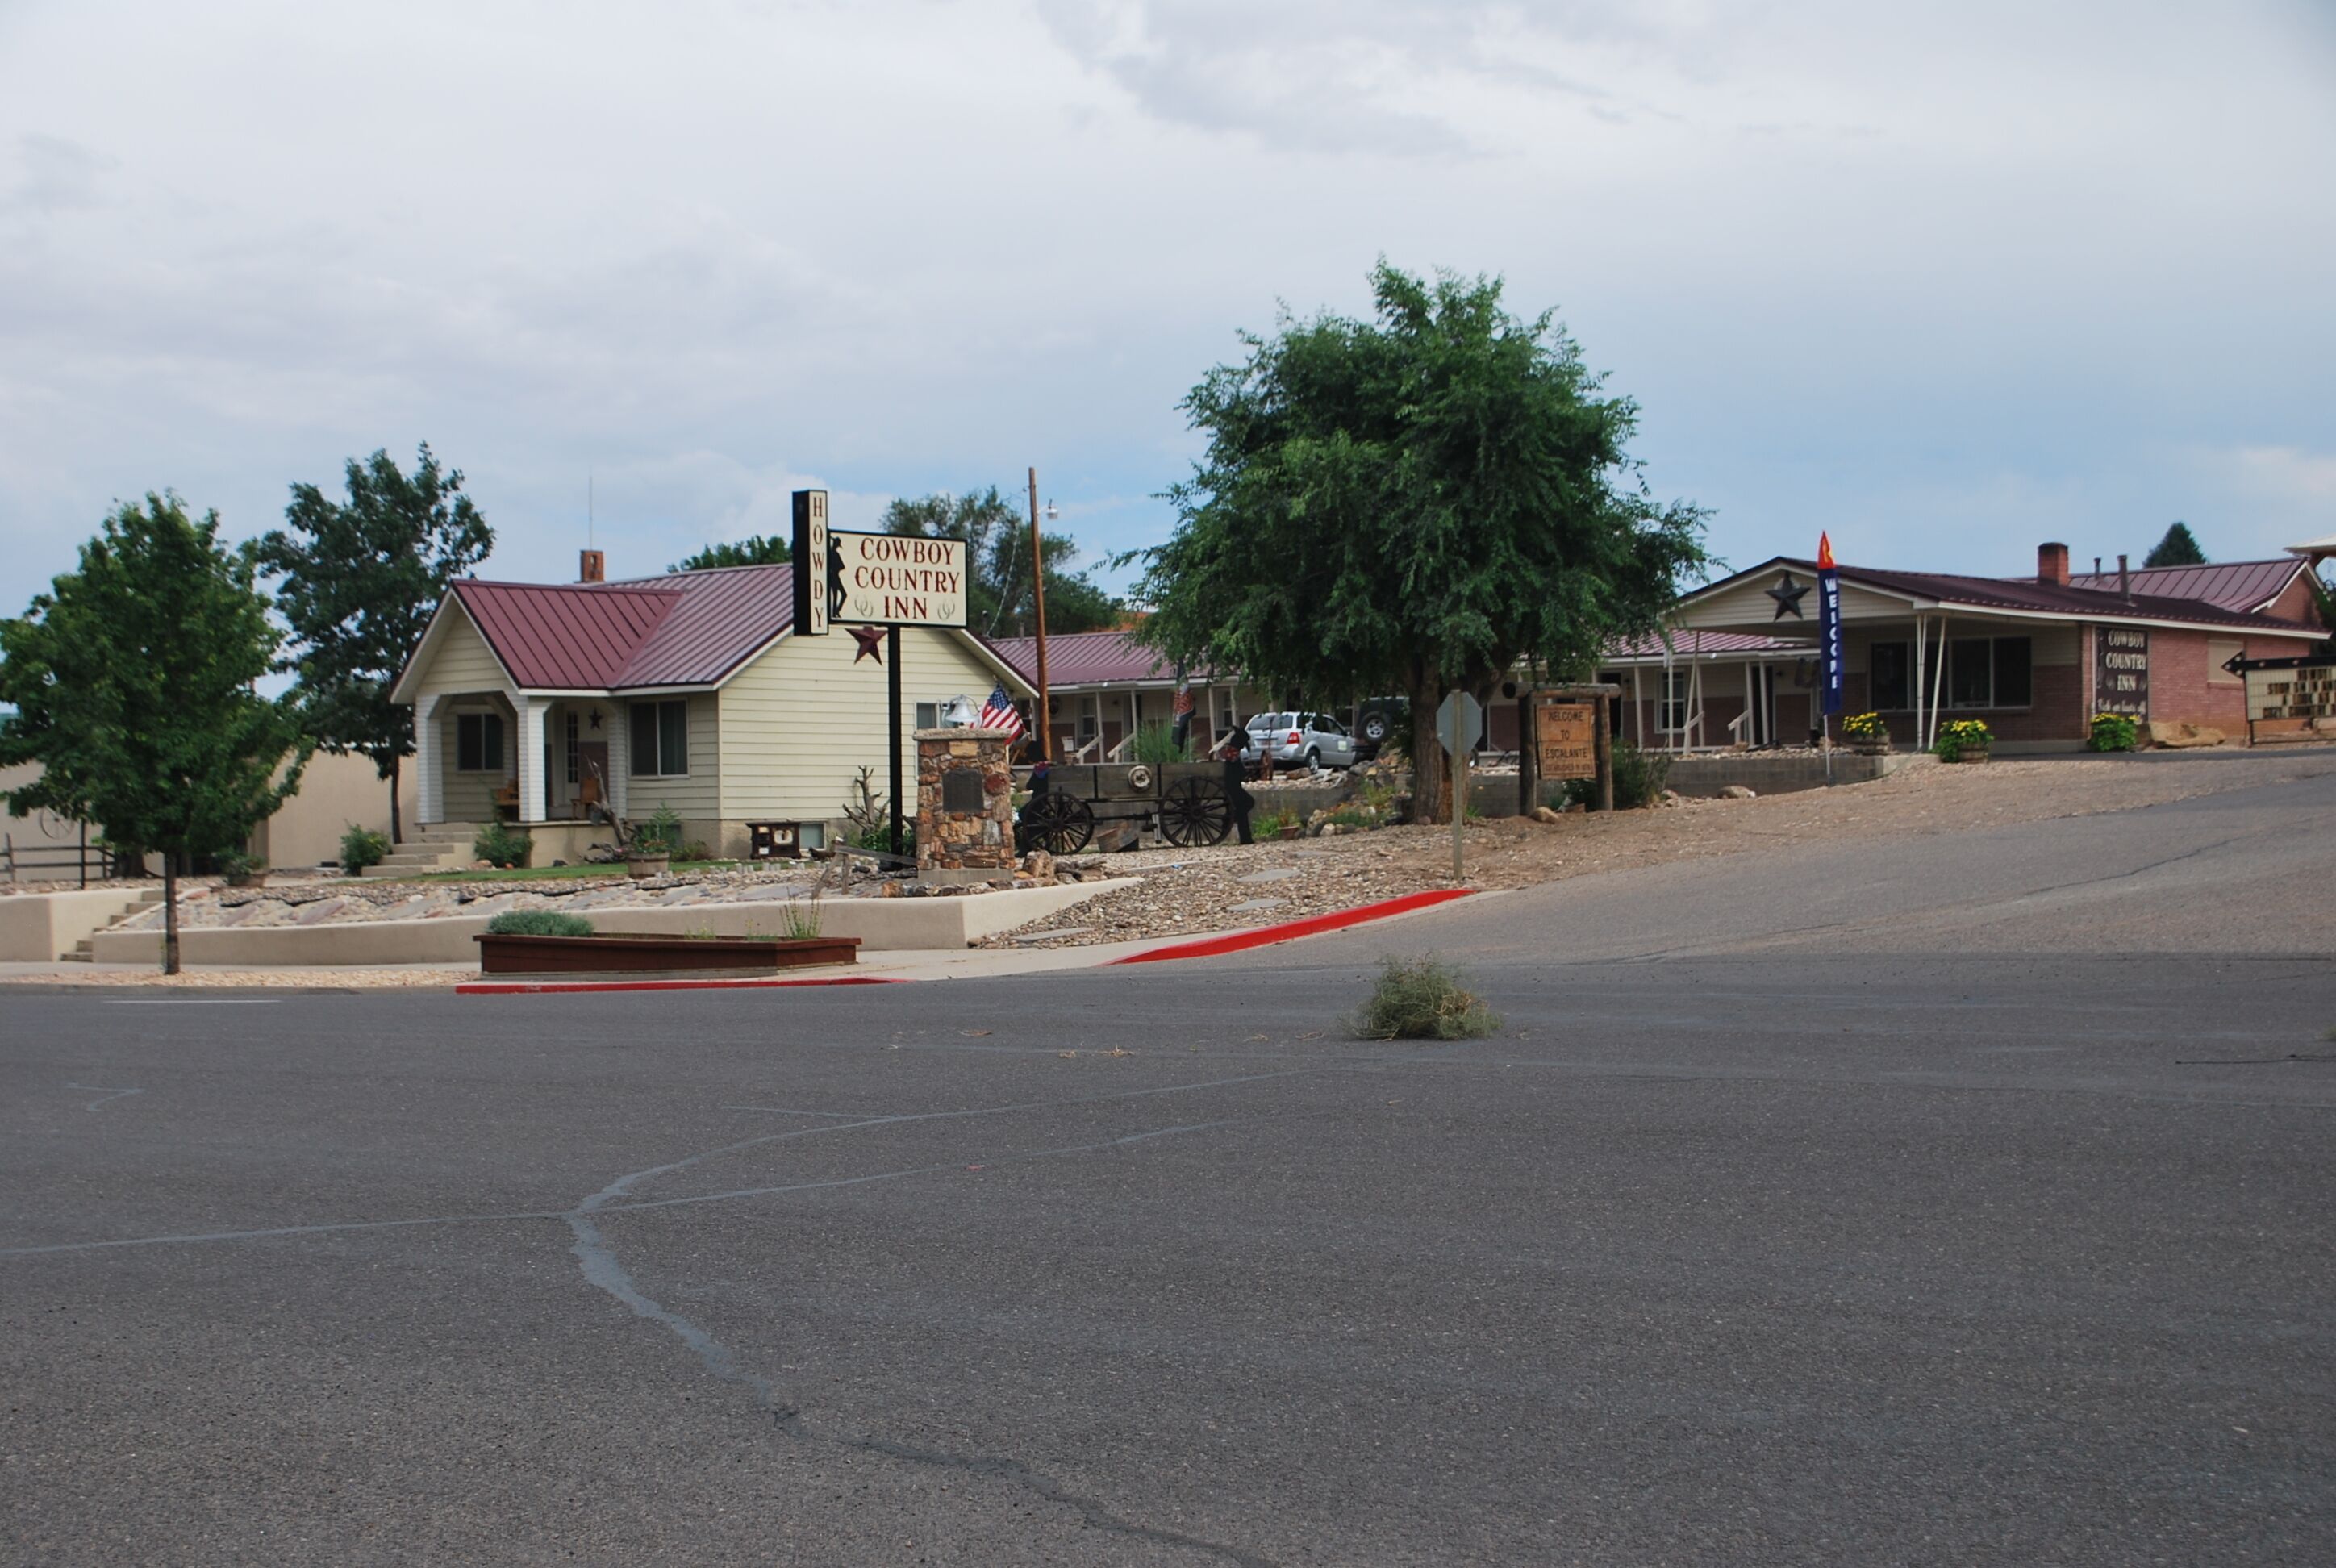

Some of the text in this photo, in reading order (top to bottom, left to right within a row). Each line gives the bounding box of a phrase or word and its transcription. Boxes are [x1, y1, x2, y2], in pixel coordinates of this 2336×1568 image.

[860, 537, 954, 565] COWBOY
[812, 497, 824, 628] HOWDY
[854, 565, 960, 594] COUNTRY
[884, 596, 927, 619] INN
[2108, 630, 2145, 648] COWBOY
[2105, 652, 2146, 670] COUNTRY
[2117, 674, 2136, 691] INN
[1548, 711, 1583, 722] WELCOME
[1560, 729, 1570, 740] TO
[1545, 748, 1587, 759] ESCALANTE
